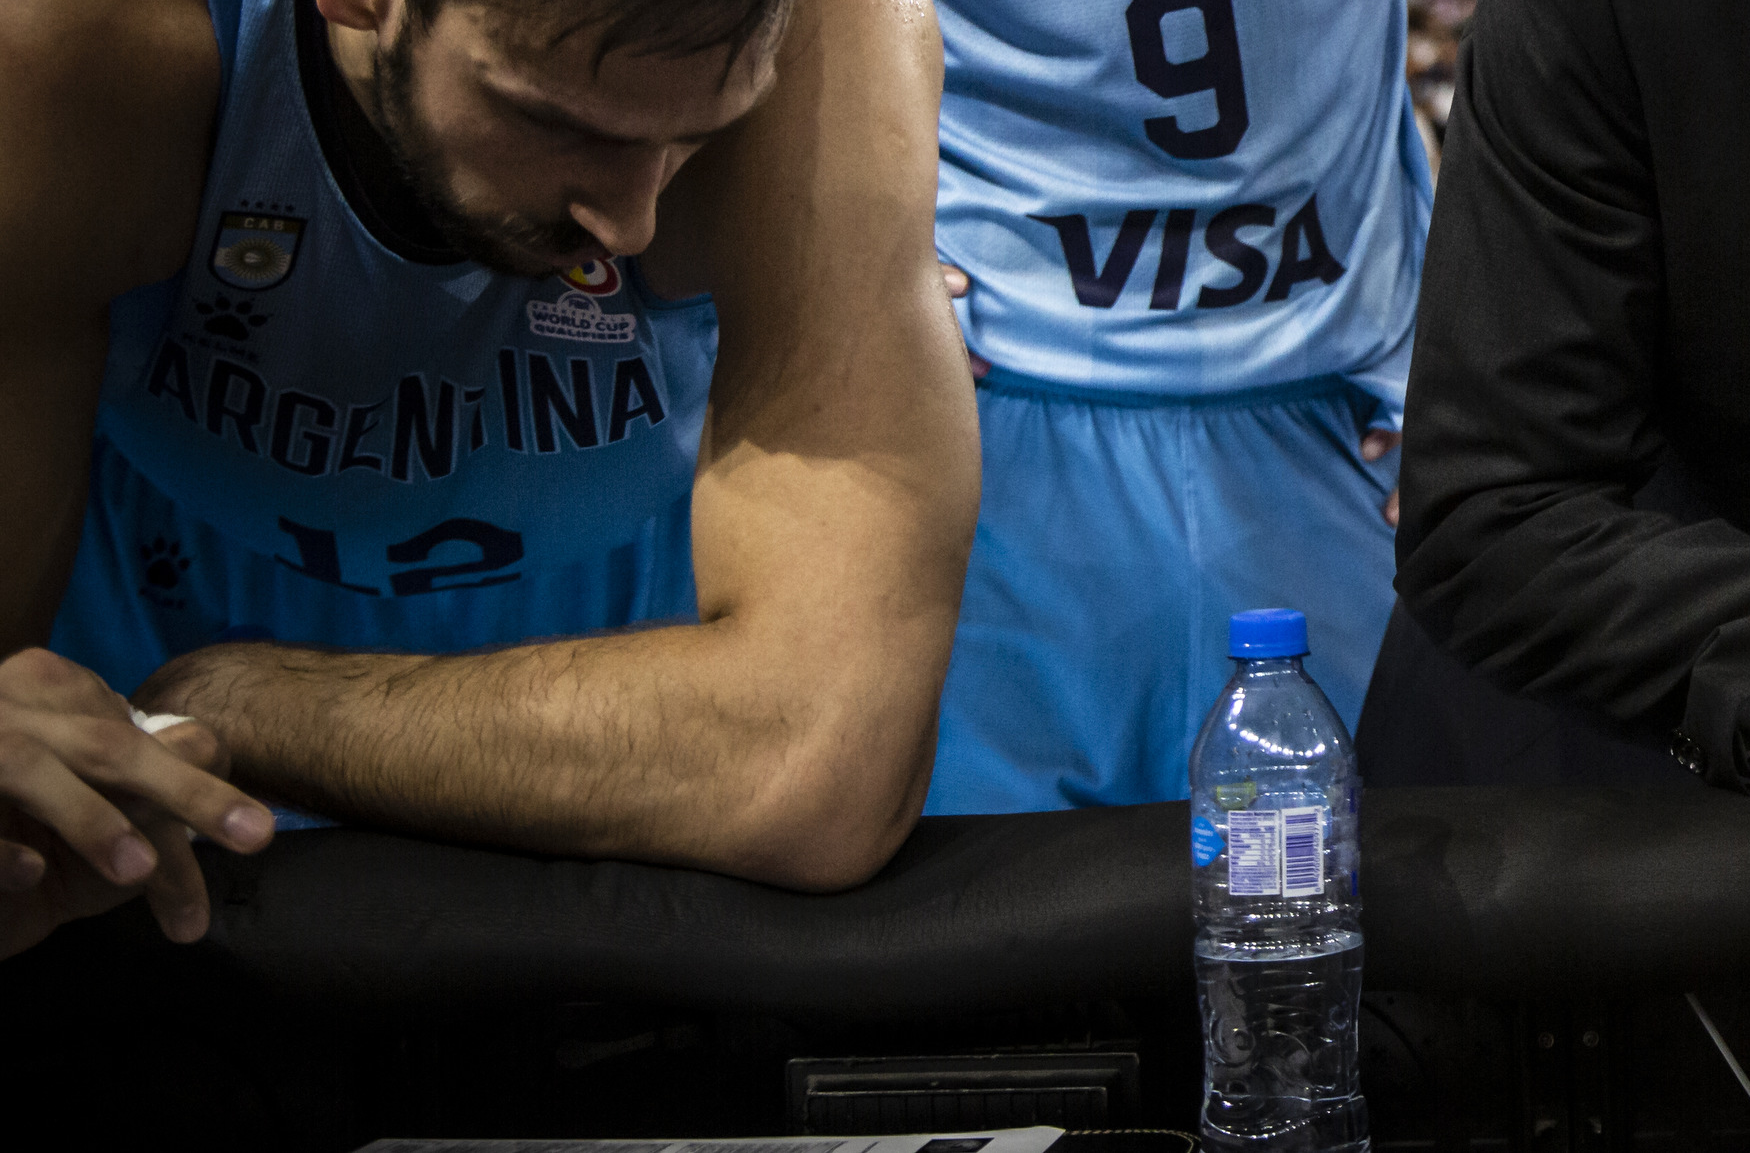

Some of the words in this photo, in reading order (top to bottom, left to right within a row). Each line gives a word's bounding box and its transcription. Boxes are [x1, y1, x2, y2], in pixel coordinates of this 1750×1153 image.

[243, 216, 286, 232] CAB
[1024, 192, 1348, 311] VISA
[532, 310, 591, 330] WORLD
[594, 320, 630, 332] CUP
[275, 516, 525, 597] 12
